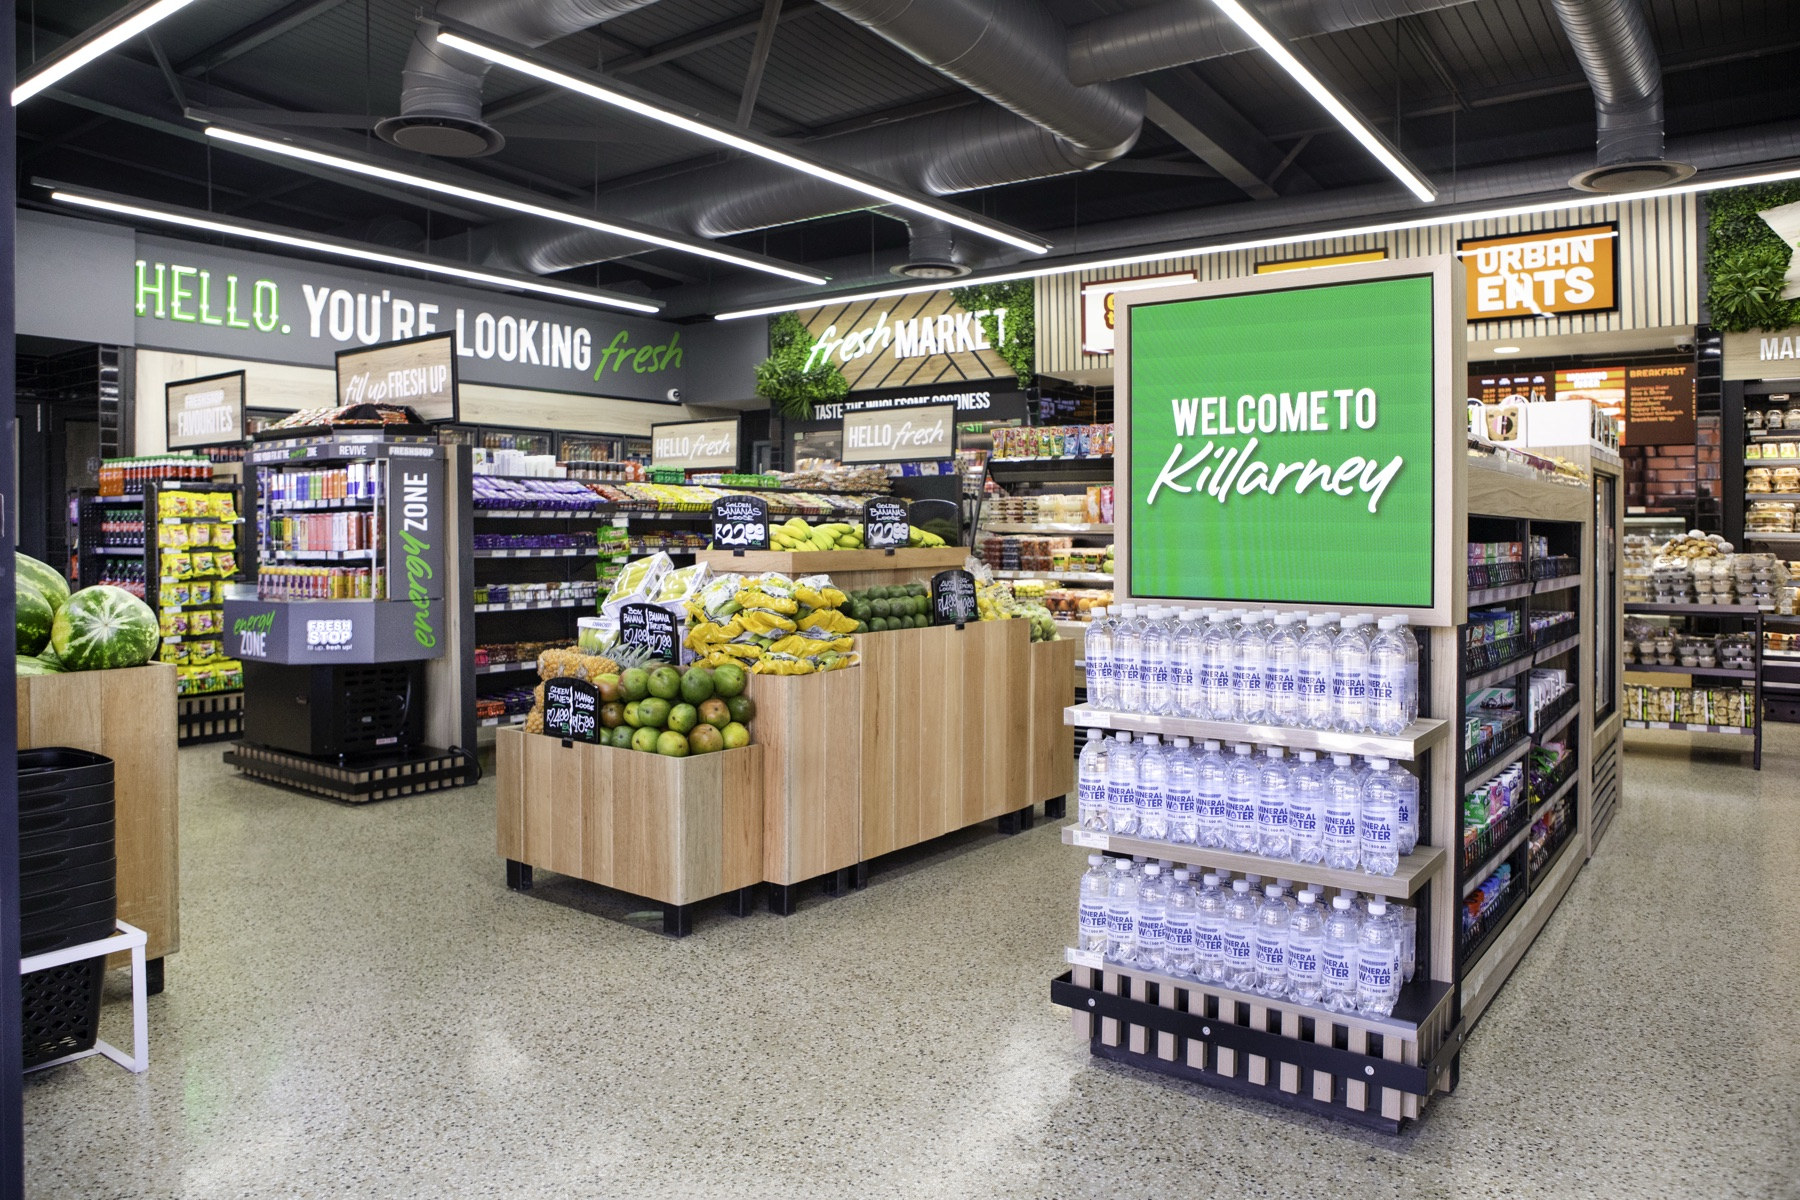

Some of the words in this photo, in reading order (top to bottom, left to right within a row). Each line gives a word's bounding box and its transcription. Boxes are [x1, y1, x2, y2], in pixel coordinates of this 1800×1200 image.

[1477, 239, 1594, 274] URBAN
[1478, 266, 1595, 312] EATS
[135, 260, 291, 335] HELLO.
[456, 309, 592, 371] LOOKING
[594, 329, 684, 382] fresh
[803, 311, 891, 373] fresh
[895, 308, 1008, 359] MARKET
[1629, 367, 1686, 378] BREAKFAST
[345, 372, 369, 404] fill
[368, 384, 387, 403] up
[388, 369, 427, 399] FRESH
[430, 366, 447, 393] UP
[814, 404, 843, 420] TASTE
[1171, 390, 1329, 436] WELCOME
[1333, 387, 1376, 430] TO
[178, 405, 233, 437] FAVOURITES
[849, 424, 892, 448] HELLO
[892, 420, 943, 450] fresh
[339, 445, 367, 456] REVIVE
[656, 436, 689, 459] HELLO
[689, 434, 730, 460] fresh
[1146, 437, 1403, 513] Killarney
[403, 472, 428, 531] ZONE
[717, 507, 762, 516] BANANAS
[869, 508, 907, 517] BANANAS
[399, 529, 436, 648] energy
[234, 610, 276, 635] energy
[623, 613, 645, 624] BANANA
[649, 611, 671, 623] BANANA
[307, 619, 353, 631] FRESH
[240, 630, 267, 657] ZONE
[307, 630, 353, 645] STOP
[1332, 678, 1365, 687] MINERAL
[550, 686, 570, 695] QUEEN
[1332, 685, 1365, 696] WATER
[574, 691, 595, 704] MANGO
[575, 701, 595, 711] LOOSE
[1166, 793, 1195, 802] MINERAL
[1196, 797, 1225, 806] MINERAL
[1166, 800, 1195, 811] WATER
[1196, 804, 1225, 815] WATER
[1258, 805, 1288, 815] MINERAL
[1226, 809, 1254, 820] WATER
[1258, 812, 1288, 824] WATER
[1324, 823, 1355, 835] WATER
[1080, 915, 1107, 926] WATER
[1138, 920, 1165, 929] MINERA
[1359, 963, 1391, 975] MINERAL
[1359, 971, 1391, 985] WATER
